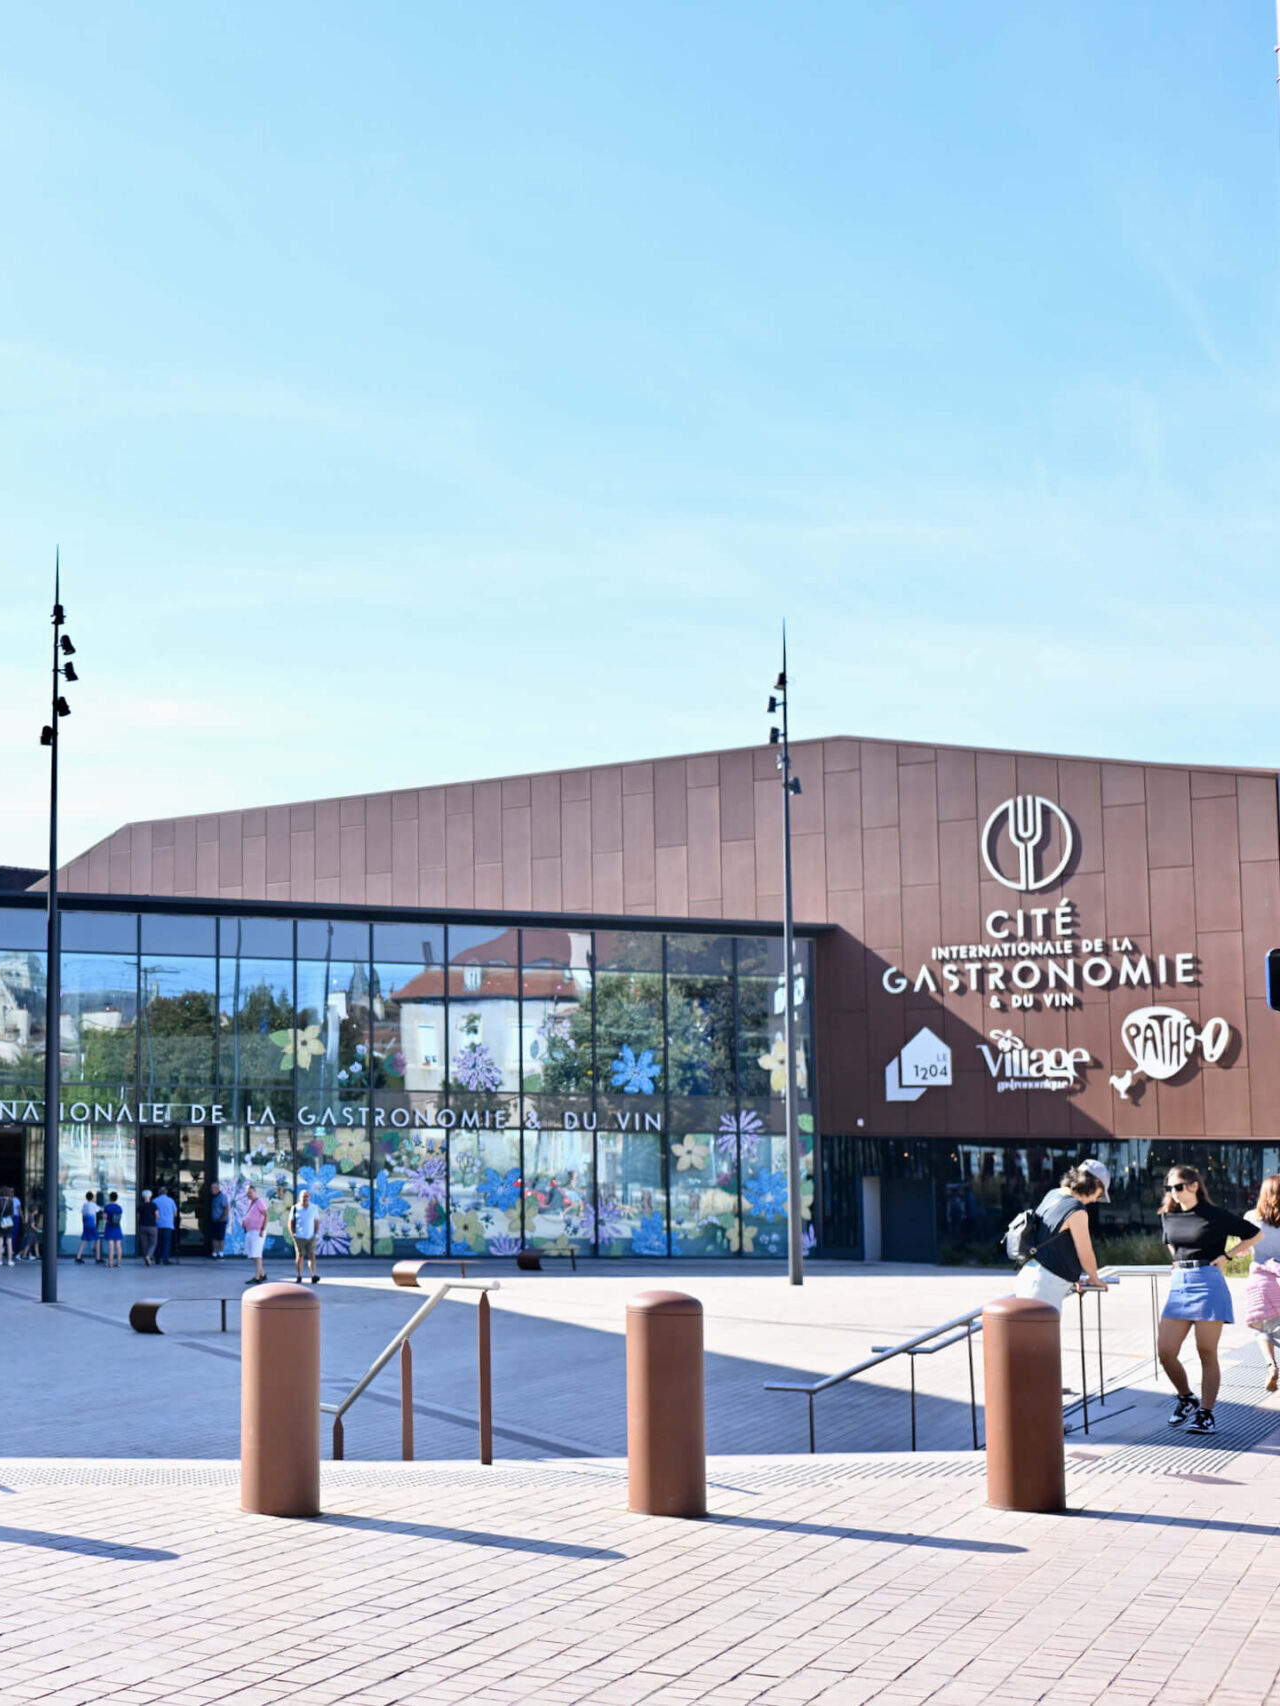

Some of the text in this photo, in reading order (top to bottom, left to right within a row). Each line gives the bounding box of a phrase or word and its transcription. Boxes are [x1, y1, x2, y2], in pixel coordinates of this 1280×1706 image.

[985, 897, 1073, 939] CITÉ
[931, 937, 1133, 961] INTERNATIONALE DE LA
[881, 953, 1195, 994] GASTRONOMIE
[989, 992, 1074, 1009] & DU VIN
[912, 1064, 948, 1080] 1204
[975, 1044, 1091, 1087] Village
[191, 1104, 222, 1124] DE
[247, 1105, 276, 1125] LA
[297, 1106, 507, 1129] GASTRONOMIE
[524, 1111, 541, 1130] &
[564, 1111, 597, 1131] DU
[616, 1112, 662, 1131] VIN
